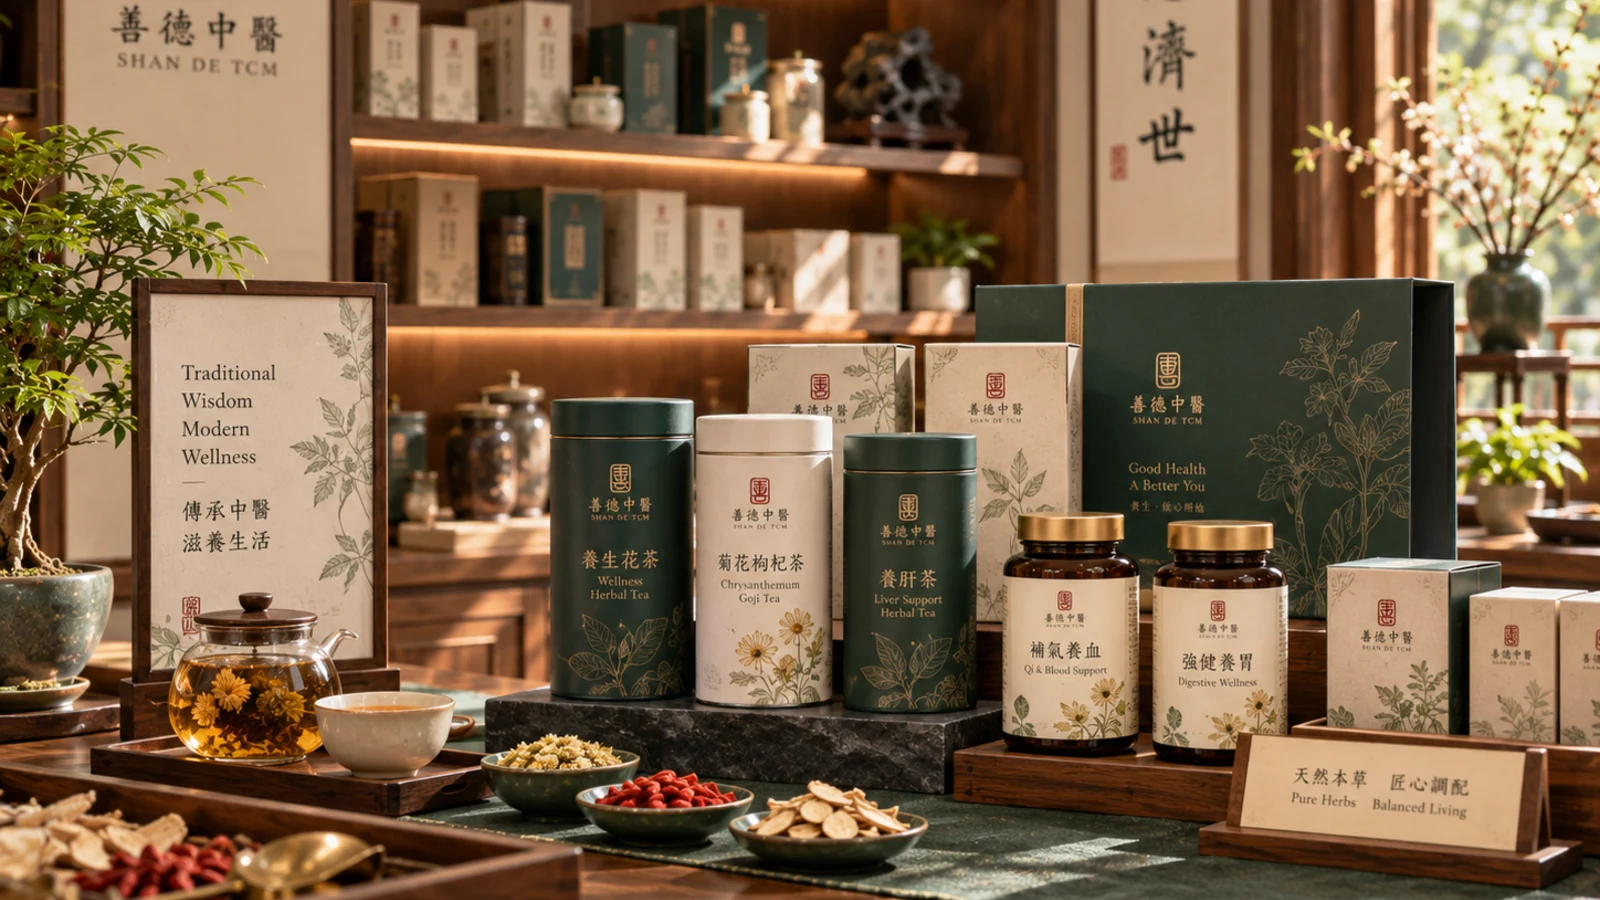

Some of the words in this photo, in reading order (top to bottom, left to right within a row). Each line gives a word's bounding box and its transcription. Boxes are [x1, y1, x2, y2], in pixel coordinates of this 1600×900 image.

[111, 4, 283, 54] 善德中醫
[117, 52, 180, 71] SHAN
[191, 56, 221, 74] DE
[231, 59, 278, 77] TCM
[1138, 0, 1197, 165] 濟世
[180, 363, 276, 381] Traditional
[181, 391, 253, 409] Wisdom
[1129, 394, 1205, 414] 善德中醫
[182, 419, 250, 438] Modern
[1133, 416, 1160, 425] SHAN
[1164, 416, 1178, 426] DE
[1181, 416, 1203, 425] TCM
[181, 447, 257, 465] Wellness
[1128, 461, 1162, 475] Good
[1165, 462, 1207, 476] Health
[1129, 479, 1140, 491] A
[1143, 479, 1180, 492] Better
[1182, 479, 1206, 493] You
[182, 498, 271, 523] 傳承中醫
[588, 496, 652, 513] 善德中醫
[182, 530, 271, 554] 滋養生活
[580, 549, 659, 570] 養生花茶
[717, 553, 805, 573] 菊花枸杞茶
[597, 575, 644, 587] Wellness
[720, 578, 801, 592] Chrysanthemum
[879, 568, 937, 589] 養肝茶
[590, 588, 627, 600] Herbal
[629, 589, 650, 600] Tea
[738, 593, 760, 606] Goji
[762, 593, 781, 604] Tea
[874, 593, 900, 605] Liver
[902, 594, 943, 607] Support
[880, 607, 915, 618] Herbal
[917, 607, 936, 618] Tea
[1029, 640, 1102, 660] 補氣養血
[1023, 664, 1034, 676] Qi
[1044, 665, 1071, 675] Blood
[1072, 666, 1108, 678] Support
[1182, 652, 1253, 672] 強健養胃
[1178, 676, 1218, 689] Digestive
[1219, 677, 1258, 688] Wellness
[1293, 767, 1367, 789] 天然本草
[1390, 773, 1470, 797] 匠心調配
[1290, 791, 1318, 805] Pure
[1321, 793, 1357, 808] Herbs
[1372, 798, 1426, 814] Balanced
[1429, 802, 1468, 821] Living
